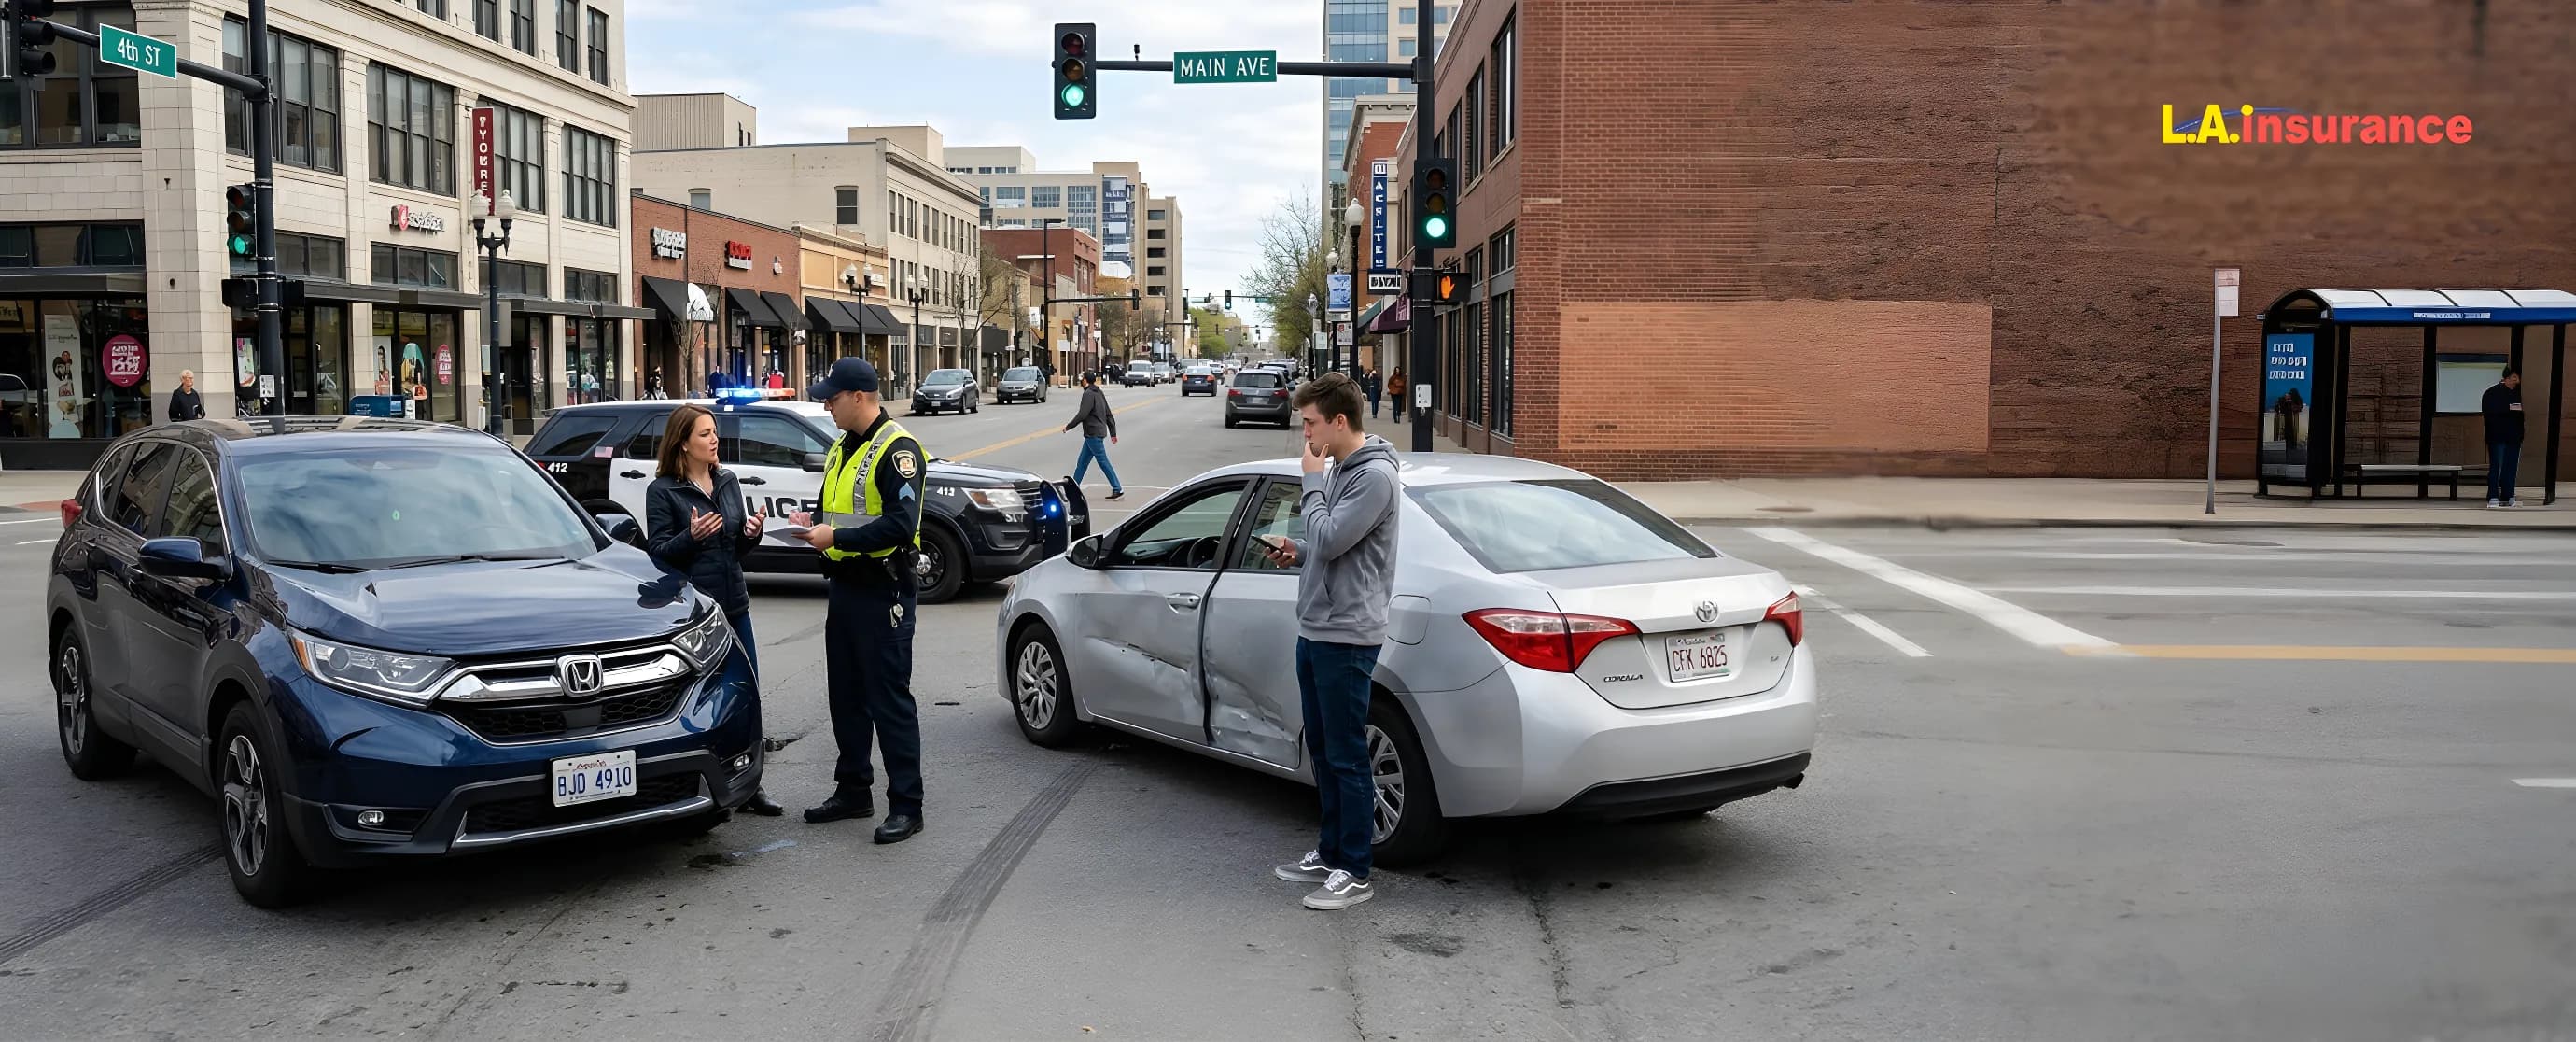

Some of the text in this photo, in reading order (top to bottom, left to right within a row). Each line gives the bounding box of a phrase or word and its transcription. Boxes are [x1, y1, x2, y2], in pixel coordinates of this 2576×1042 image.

[118, 37, 161, 67] 4th ST
[1181, 57, 1269, 77] MAIN AVE
[547, 462, 567, 472] 412
[746, 497, 818, 518] LICE
[557, 767, 631, 796] BJD 4910
